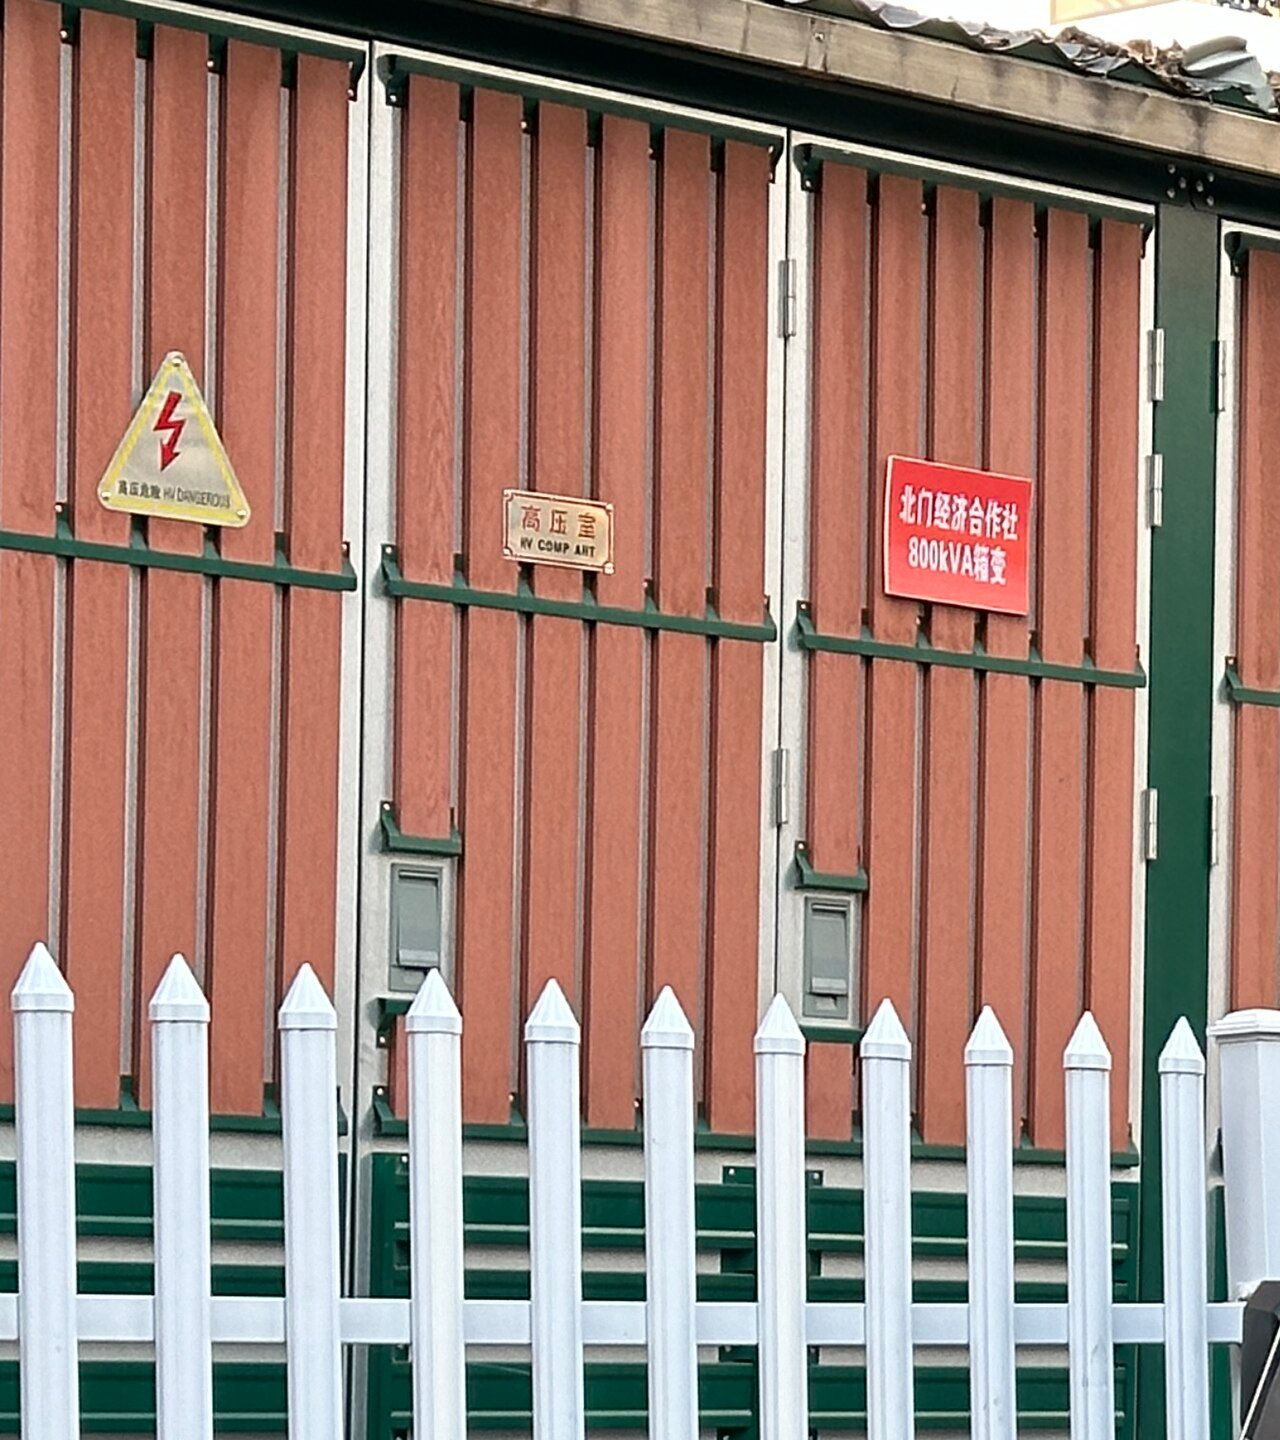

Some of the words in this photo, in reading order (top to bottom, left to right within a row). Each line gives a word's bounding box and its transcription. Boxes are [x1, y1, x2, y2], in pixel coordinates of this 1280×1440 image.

[520, 504, 596, 540] 高压室
[898, 484, 1019, 541] 北门经济合作社
